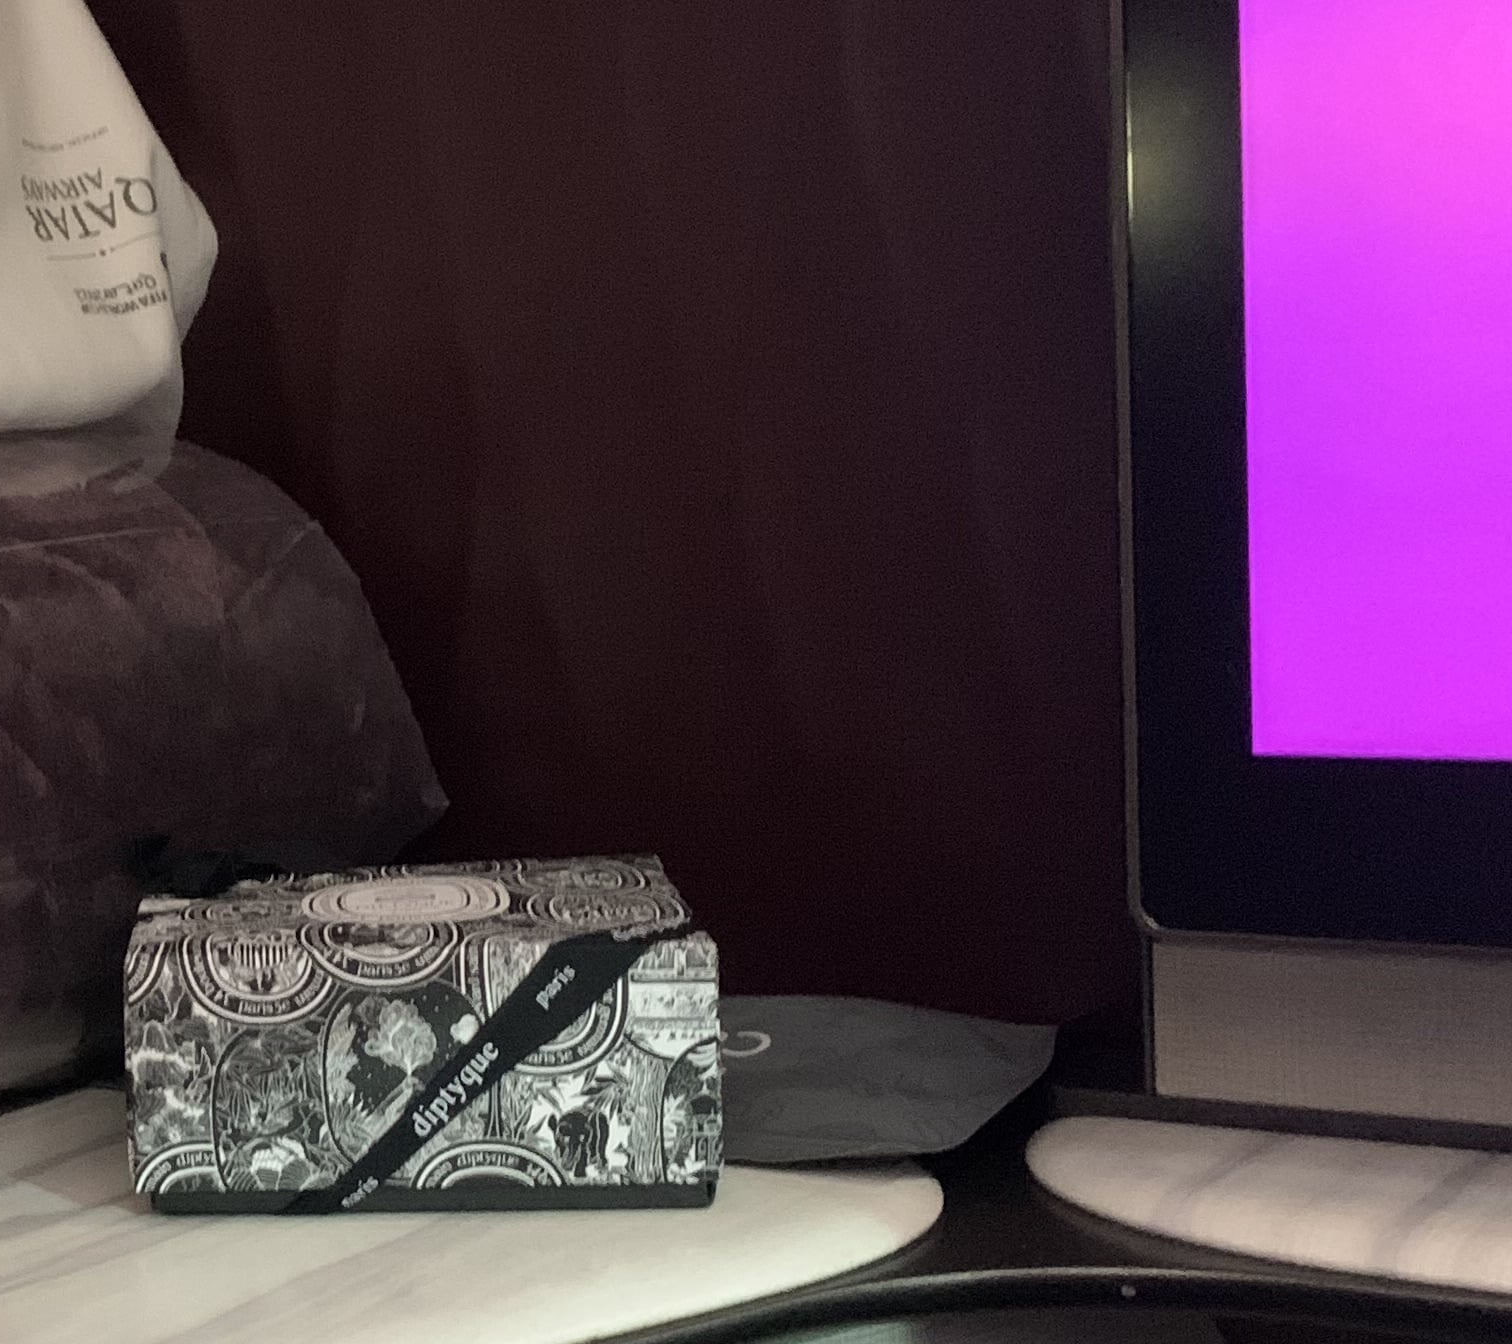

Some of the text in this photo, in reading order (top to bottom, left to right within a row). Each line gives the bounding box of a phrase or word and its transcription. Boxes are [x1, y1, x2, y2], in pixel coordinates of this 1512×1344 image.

[21, 167, 103, 201] AIRWAYS
[25, 176, 158, 242] QATAR
[535, 964, 577, 1011] paris
[411, 1041, 499, 1137] diptyque
